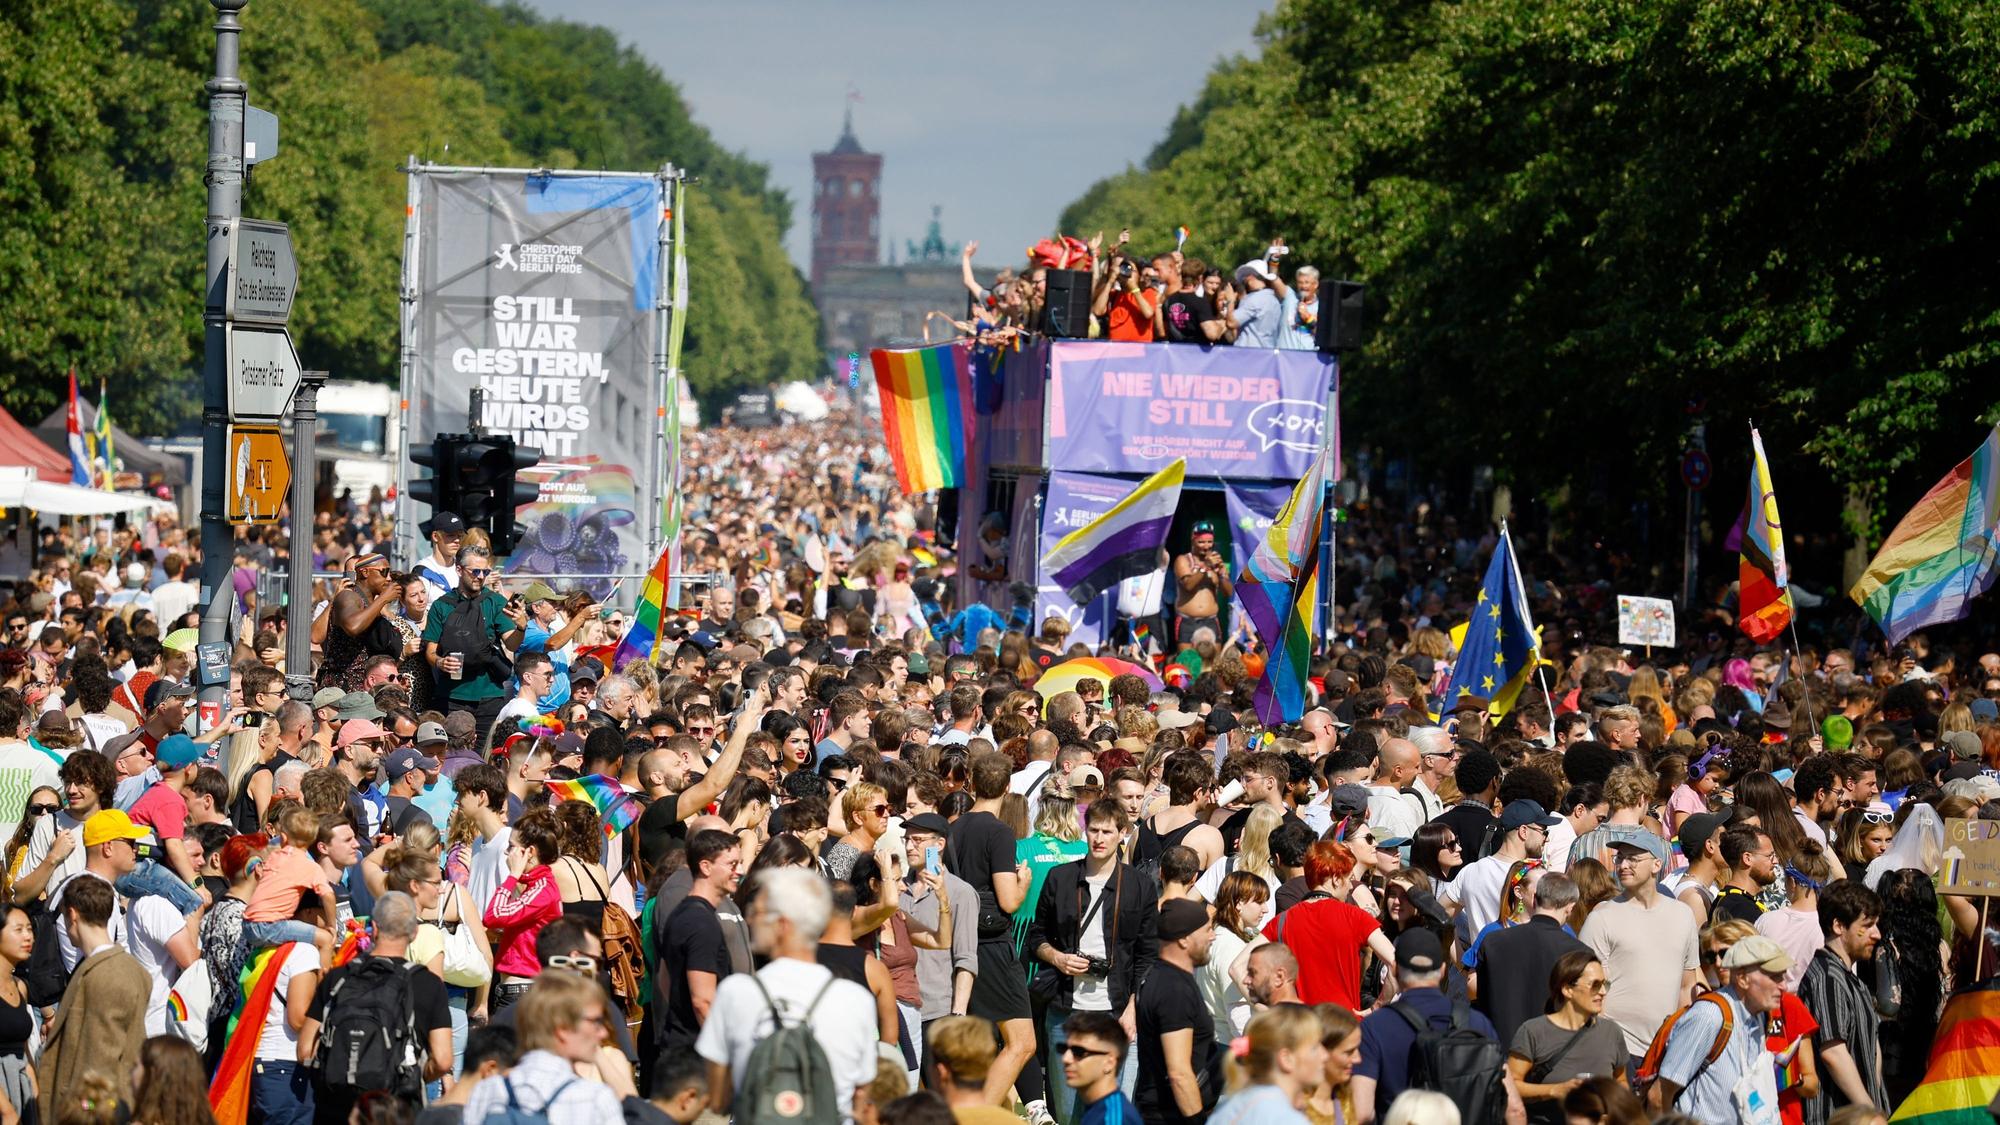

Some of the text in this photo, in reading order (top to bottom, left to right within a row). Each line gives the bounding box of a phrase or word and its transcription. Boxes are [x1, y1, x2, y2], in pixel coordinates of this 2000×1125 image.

[251, 240, 276, 276] Reichstag
[520, 244, 583, 255] CHRISTOPHER
[520, 253, 576, 265] STREET DAY
[520, 262, 583, 274] BERLIN PRIDE
[238, 277, 286, 308] Sitz des Bundestages
[493, 295, 580, 323] STILL
[496, 322, 577, 349] WAR
[241, 359, 284, 387] Potsdamer Platz
[452, 348, 609, 383] GESTERN,
[480, 375, 581, 403] HEUTE
[1103, 372, 1281, 402] NIE WIEDER
[482, 402, 590, 431] WIRDS
[1149, 399, 1233, 427] STILL
[488, 429, 579, 457] UNT
[1952, 821, 2000, 841] GEND
